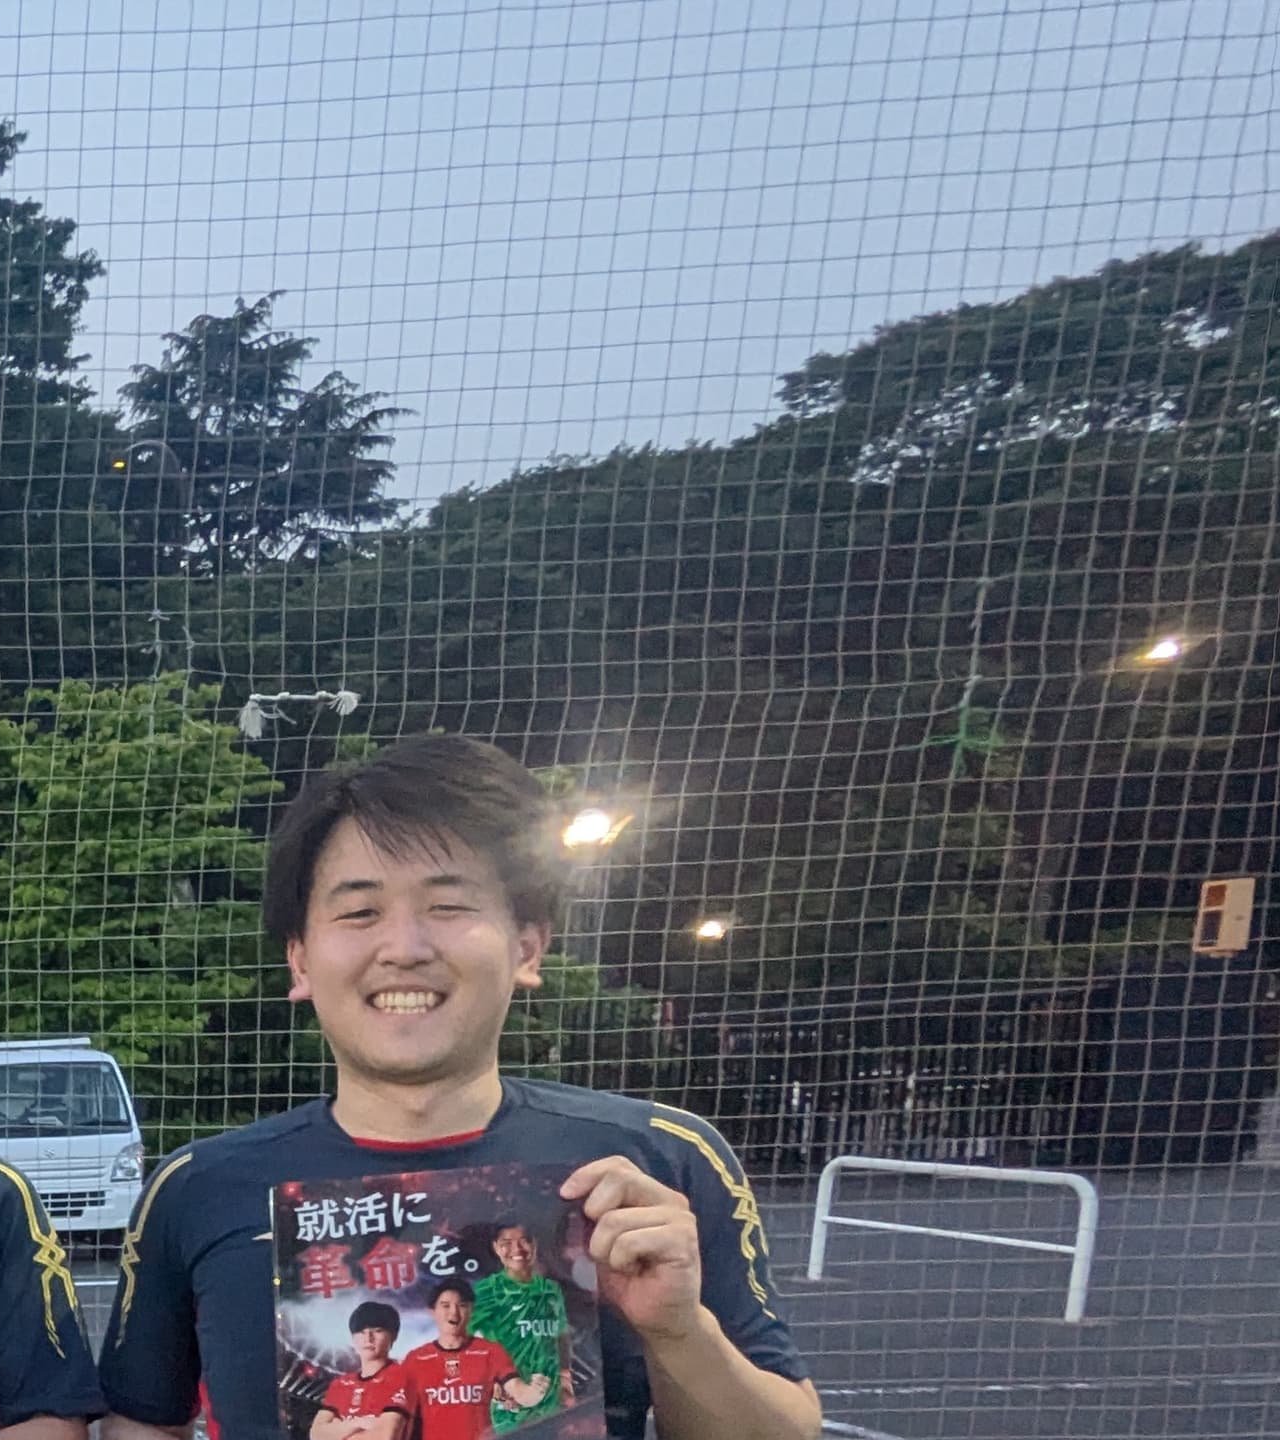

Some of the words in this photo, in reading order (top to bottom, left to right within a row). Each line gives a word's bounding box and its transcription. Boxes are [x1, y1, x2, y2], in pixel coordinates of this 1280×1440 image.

[294, 1192, 432, 1242] 就活に
[296, 1234, 480, 1300] 革命を。
[425, 1385, 483, 1406] POLUS
